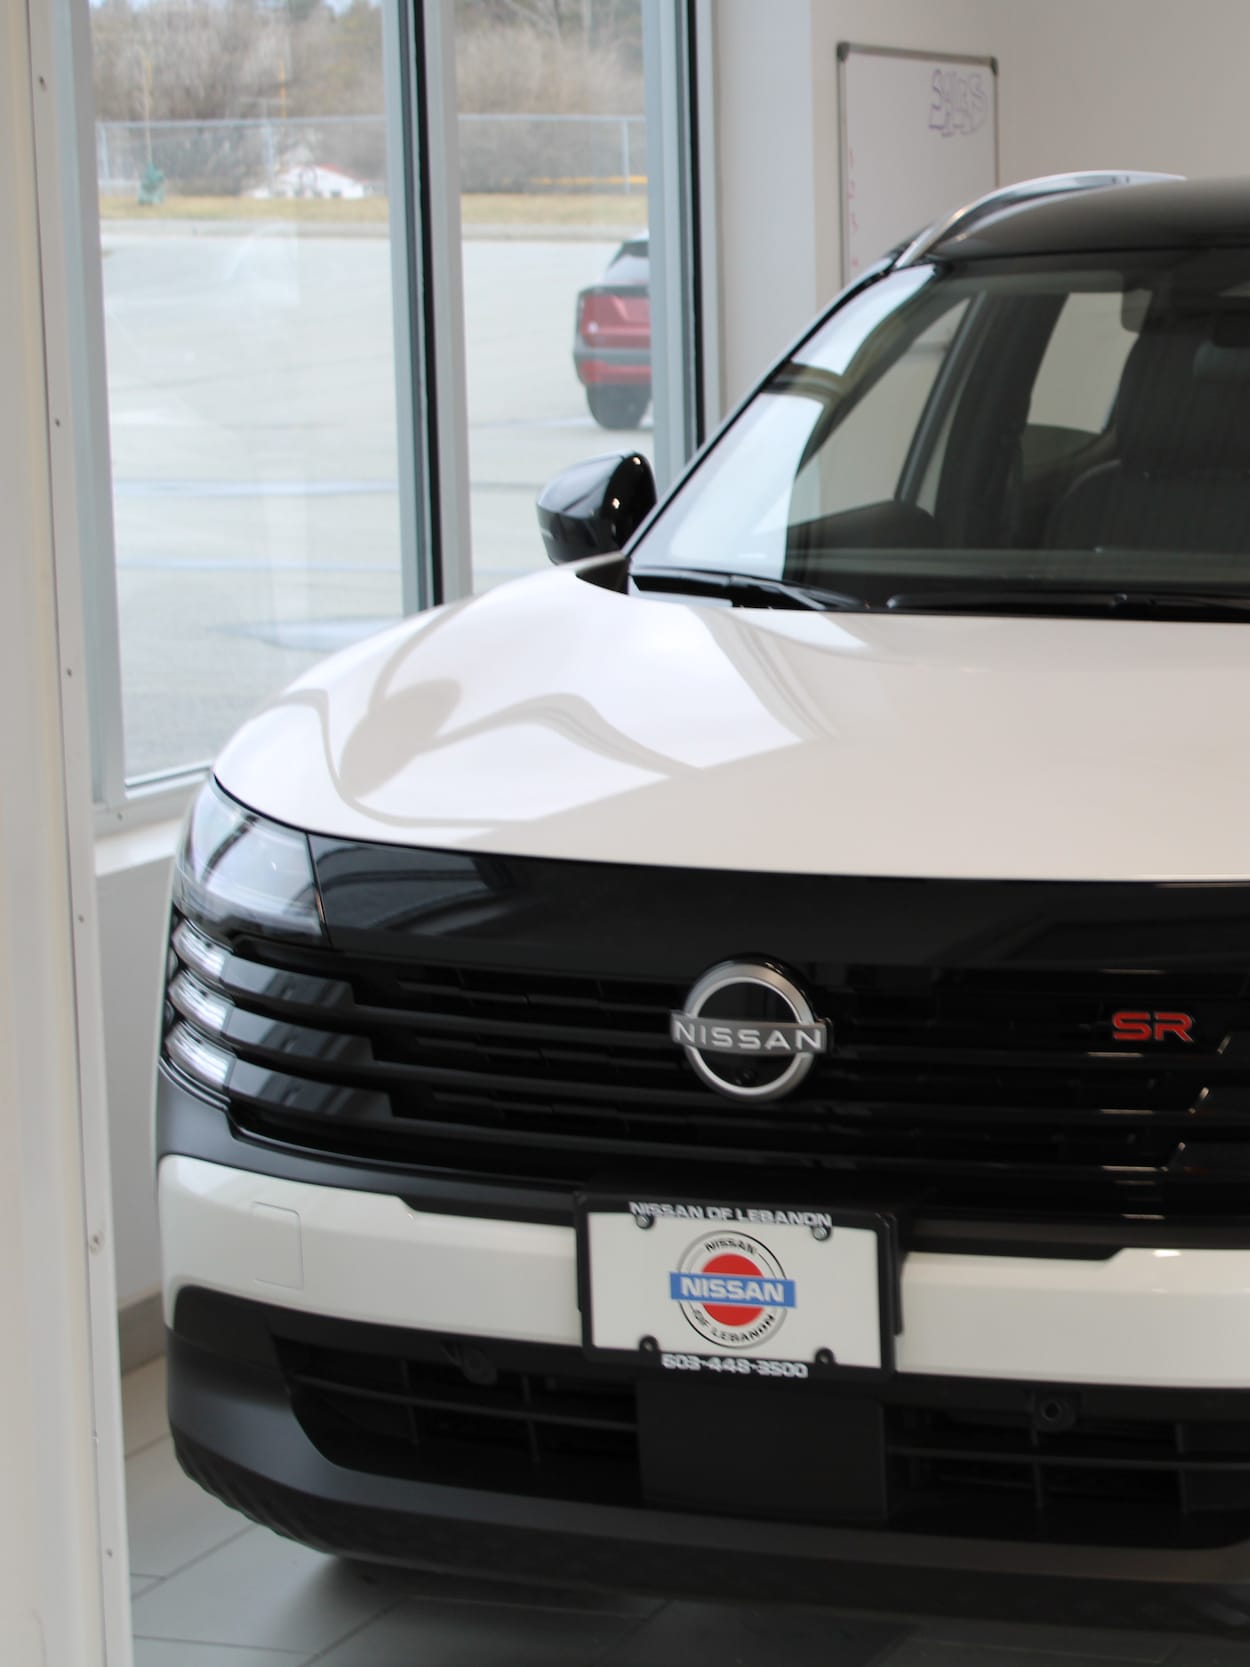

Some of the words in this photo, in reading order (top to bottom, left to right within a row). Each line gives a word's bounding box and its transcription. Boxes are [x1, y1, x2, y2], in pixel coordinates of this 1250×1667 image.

[673, 1020, 822, 1050] NISSAN
[1112, 1011, 1194, 1042] SR
[628, 1201, 704, 1220] NISSAN
[706, 1207, 733, 1221] OF
[735, 1208, 832, 1227] LEBANON
[704, 1238, 758, 1255] NISSAN
[680, 1276, 784, 1303] NISSAN
[711, 1313, 776, 1342] LEBANON
